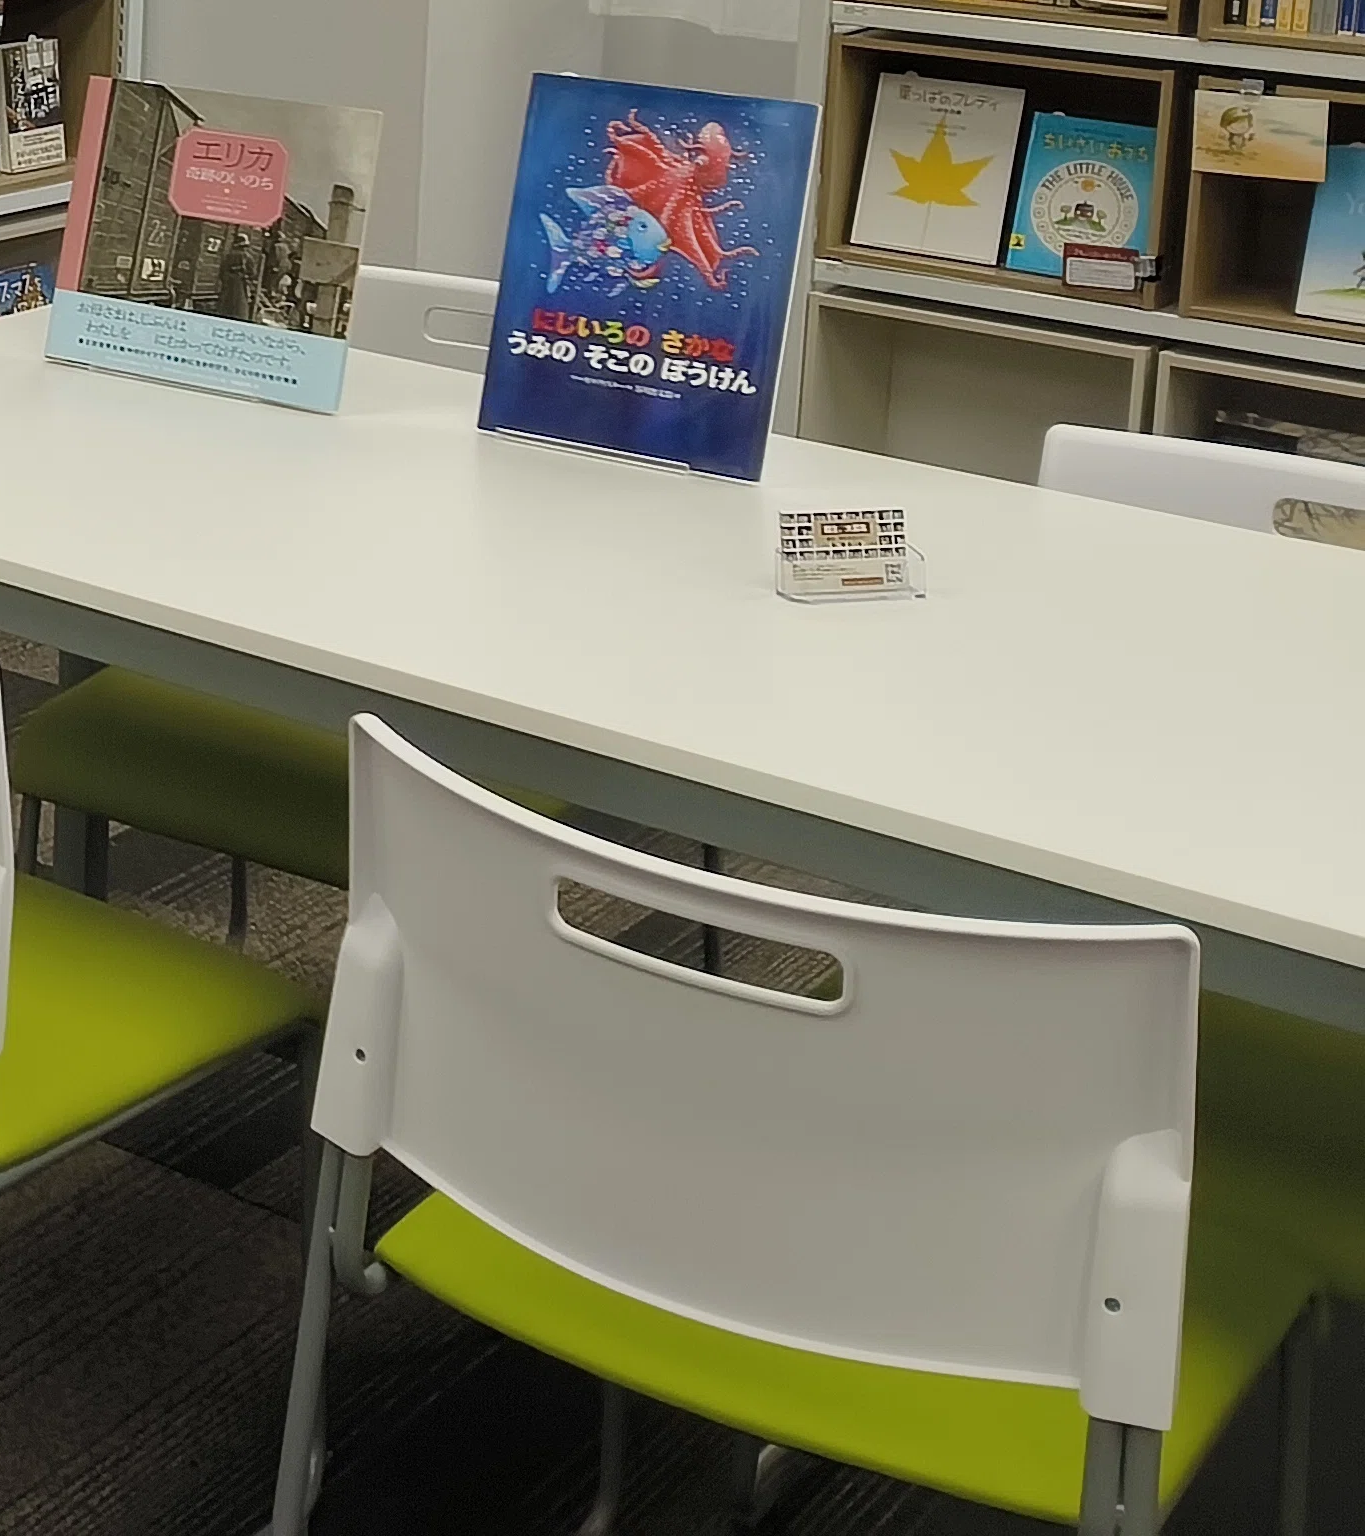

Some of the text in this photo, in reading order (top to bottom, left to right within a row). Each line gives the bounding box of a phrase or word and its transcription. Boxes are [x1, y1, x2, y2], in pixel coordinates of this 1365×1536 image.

[192, 140, 274, 173] エリカ
[1042, 132, 1148, 162] ちいさいおうち
[1040, 161, 1136, 204] THE LITTLE HOUSE
[507, 330, 577, 363] うみの
[584, 344, 656, 377] そこの
[532, 308, 736, 362] にじいろの さかな
